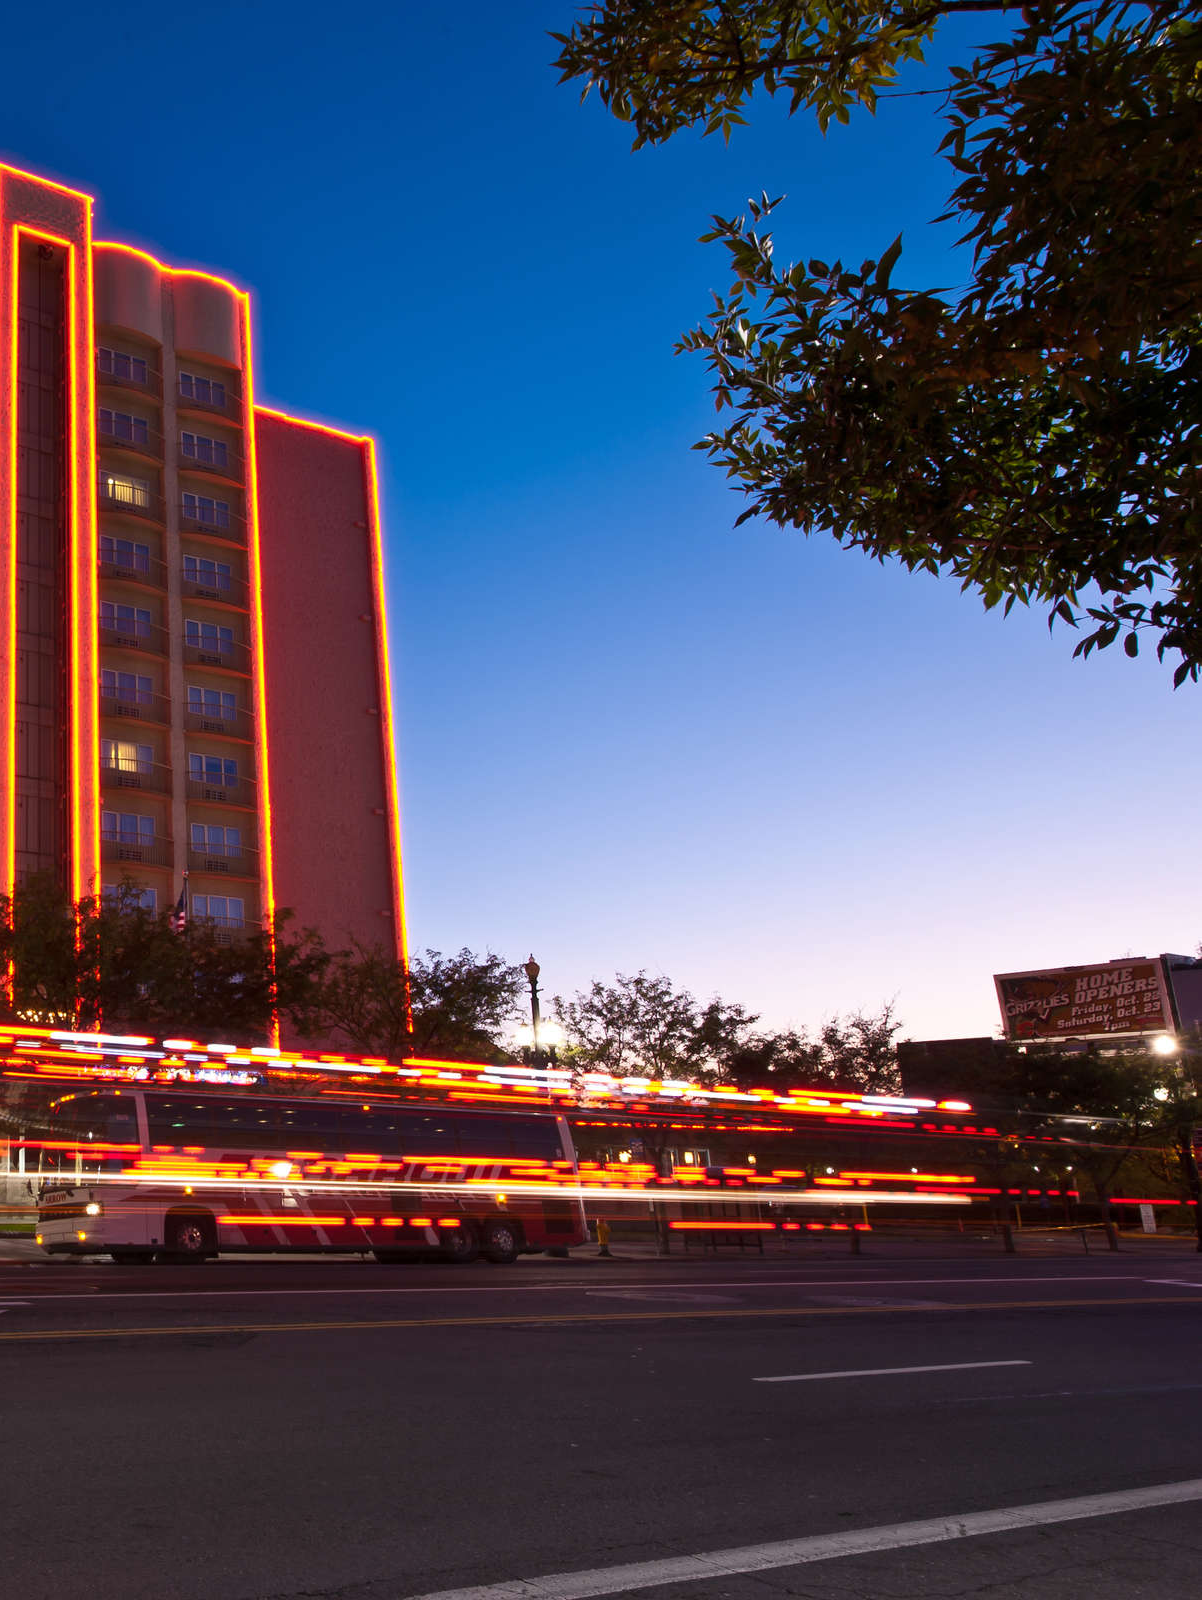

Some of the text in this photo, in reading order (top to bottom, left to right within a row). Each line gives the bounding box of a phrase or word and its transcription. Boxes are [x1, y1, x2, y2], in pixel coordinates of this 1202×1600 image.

[1074, 976, 1158, 1004] OPENERS
[1075, 967, 1134, 991] HOME
[1005, 993, 1070, 1017] GRIZZLIES
[1071, 1003, 1112, 1017] Friday,
[1116, 994, 1140, 1008] Oct.
[1056, 1013, 1114, 1030] Saturday,
[1117, 1005, 1140, 1018] Oct.
